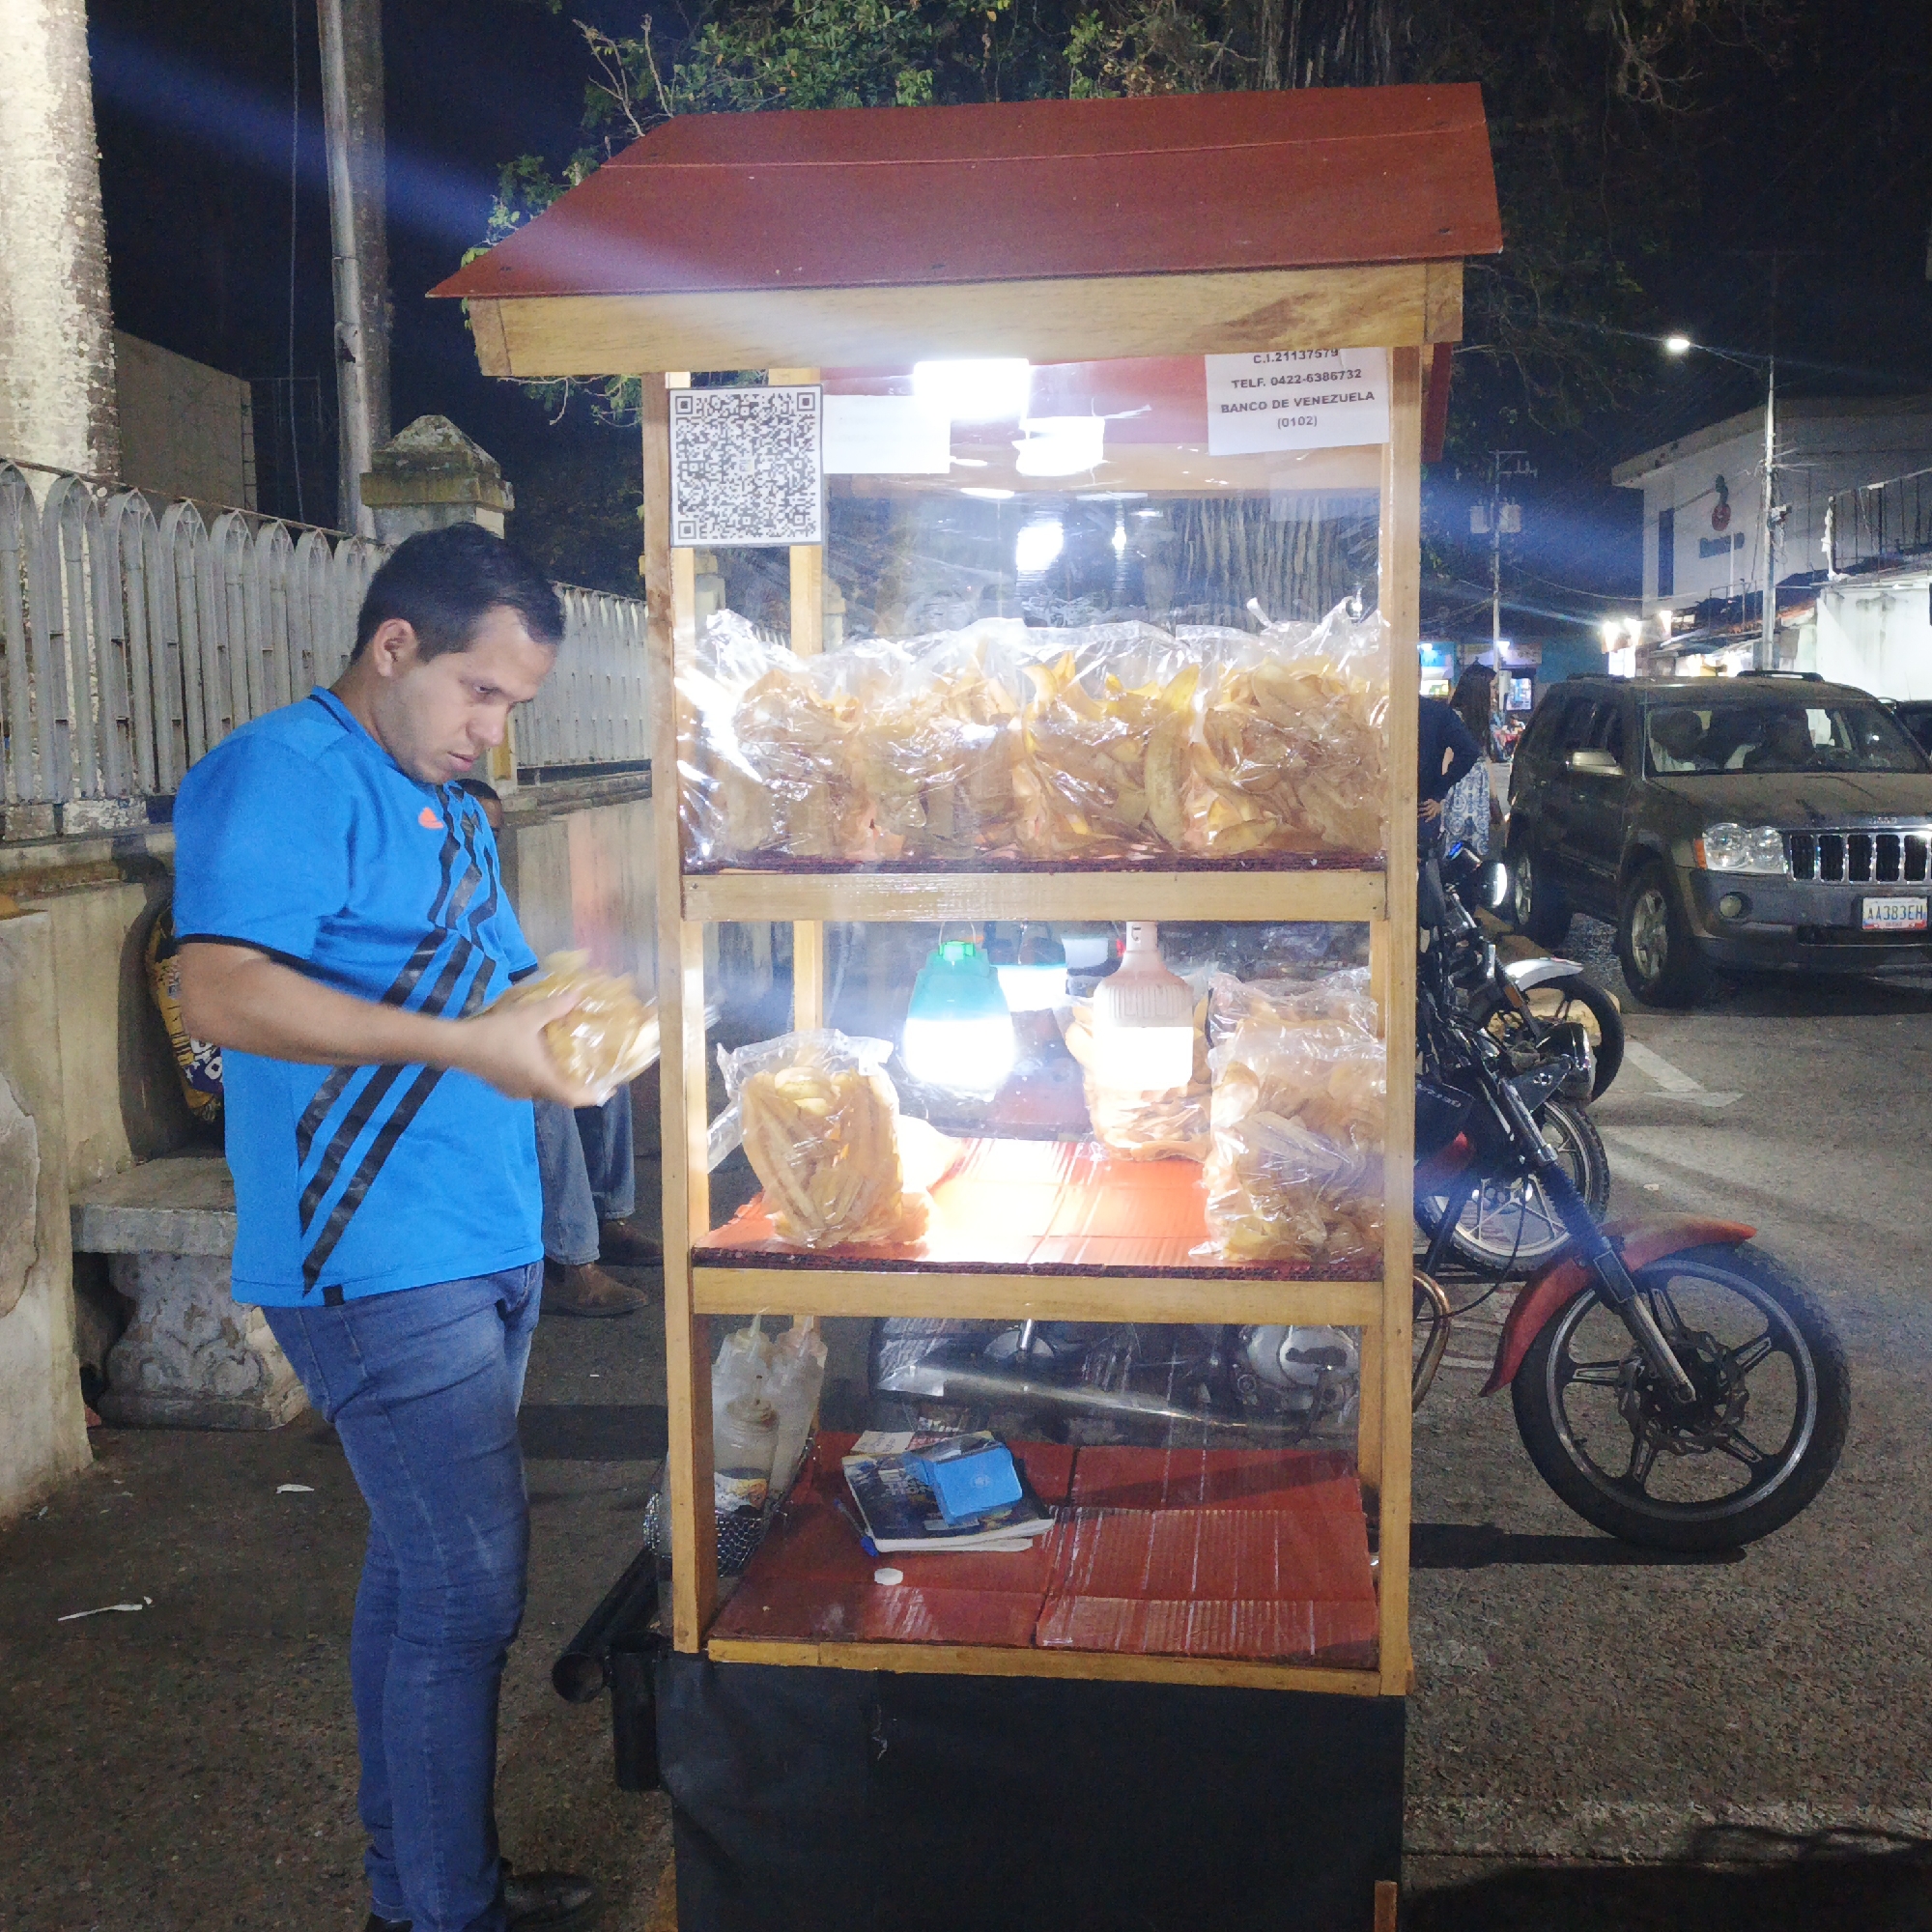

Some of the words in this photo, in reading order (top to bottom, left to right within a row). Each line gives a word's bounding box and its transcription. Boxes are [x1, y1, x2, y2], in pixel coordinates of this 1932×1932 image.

[1253, 349, 1339, 364] C.I.21137579
[1232, 378, 1266, 389] TELF.
[1270, 369, 1362, 386] 0422-6386732
[1221, 401, 1267, 413] BANCO
[1272, 399, 1290, 410] DE
[1293, 391, 1375, 407] VENEZUELA
[1277, 416, 1318, 429] (0102)
